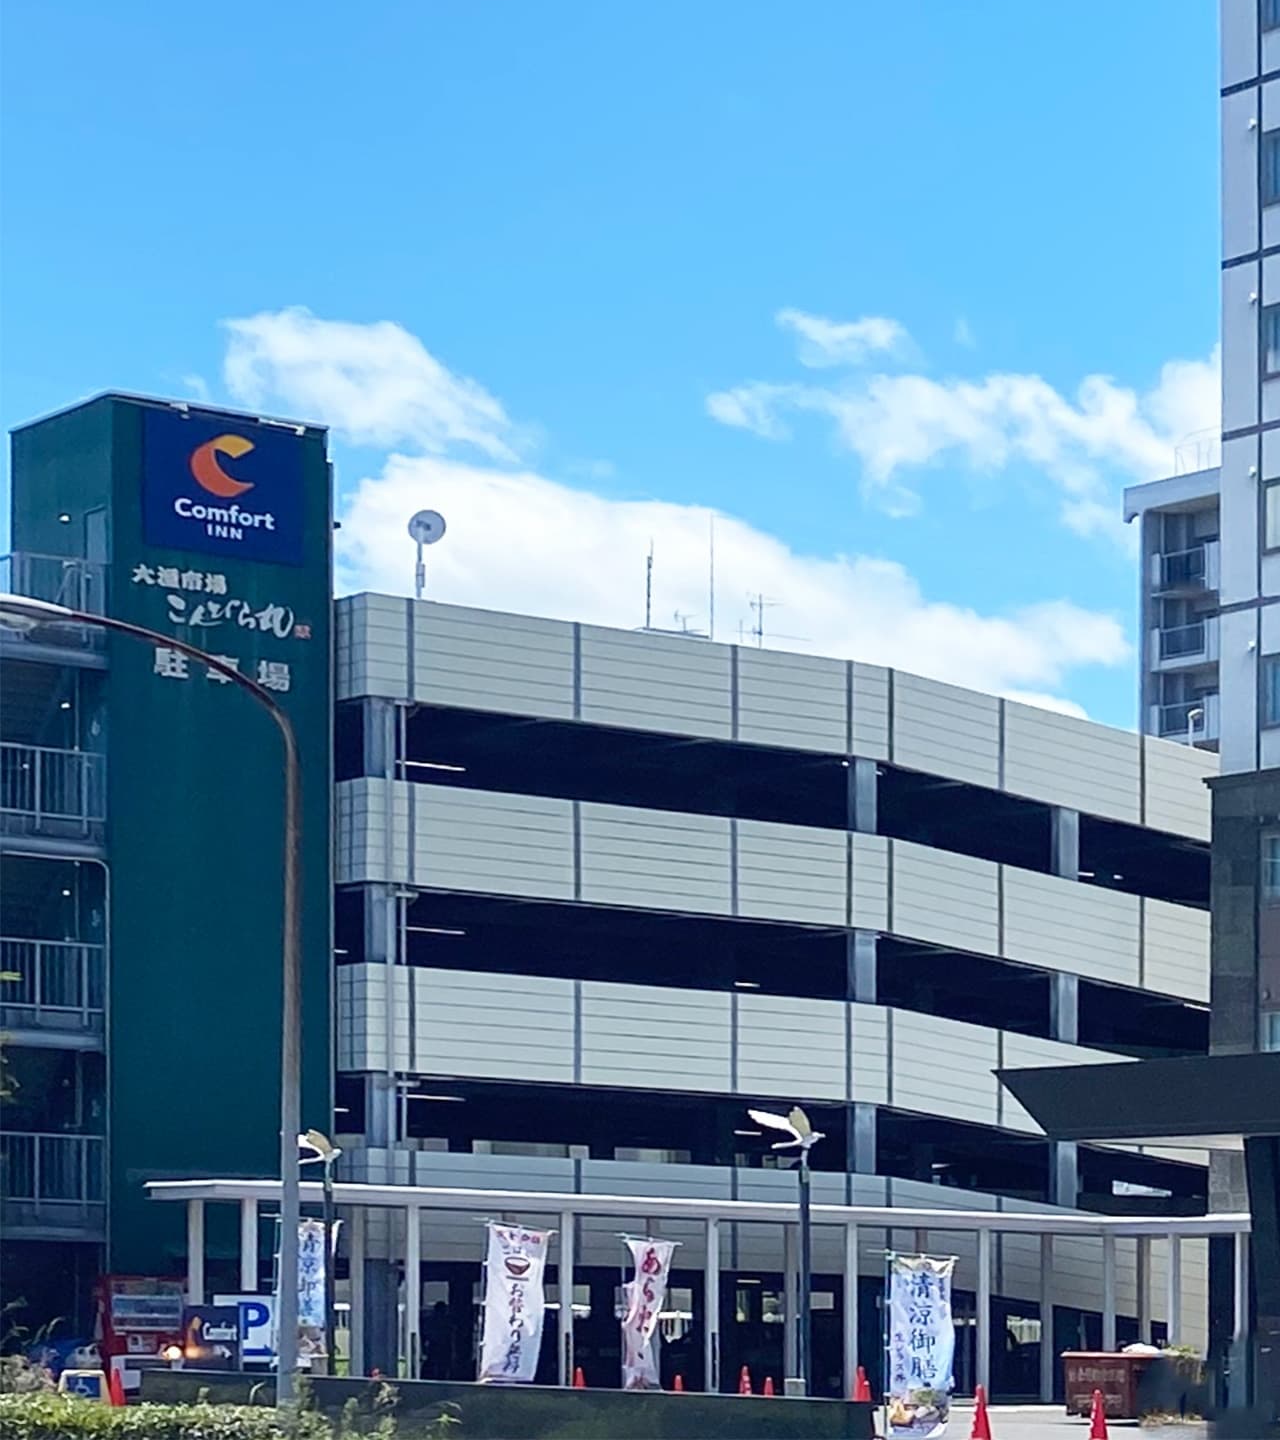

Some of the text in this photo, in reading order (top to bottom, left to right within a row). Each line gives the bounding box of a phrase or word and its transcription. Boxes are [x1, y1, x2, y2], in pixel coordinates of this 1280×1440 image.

[174, 497, 275, 531] Comfort
[206, 523, 243, 541] INN
[237, 1301, 270, 1340] P
